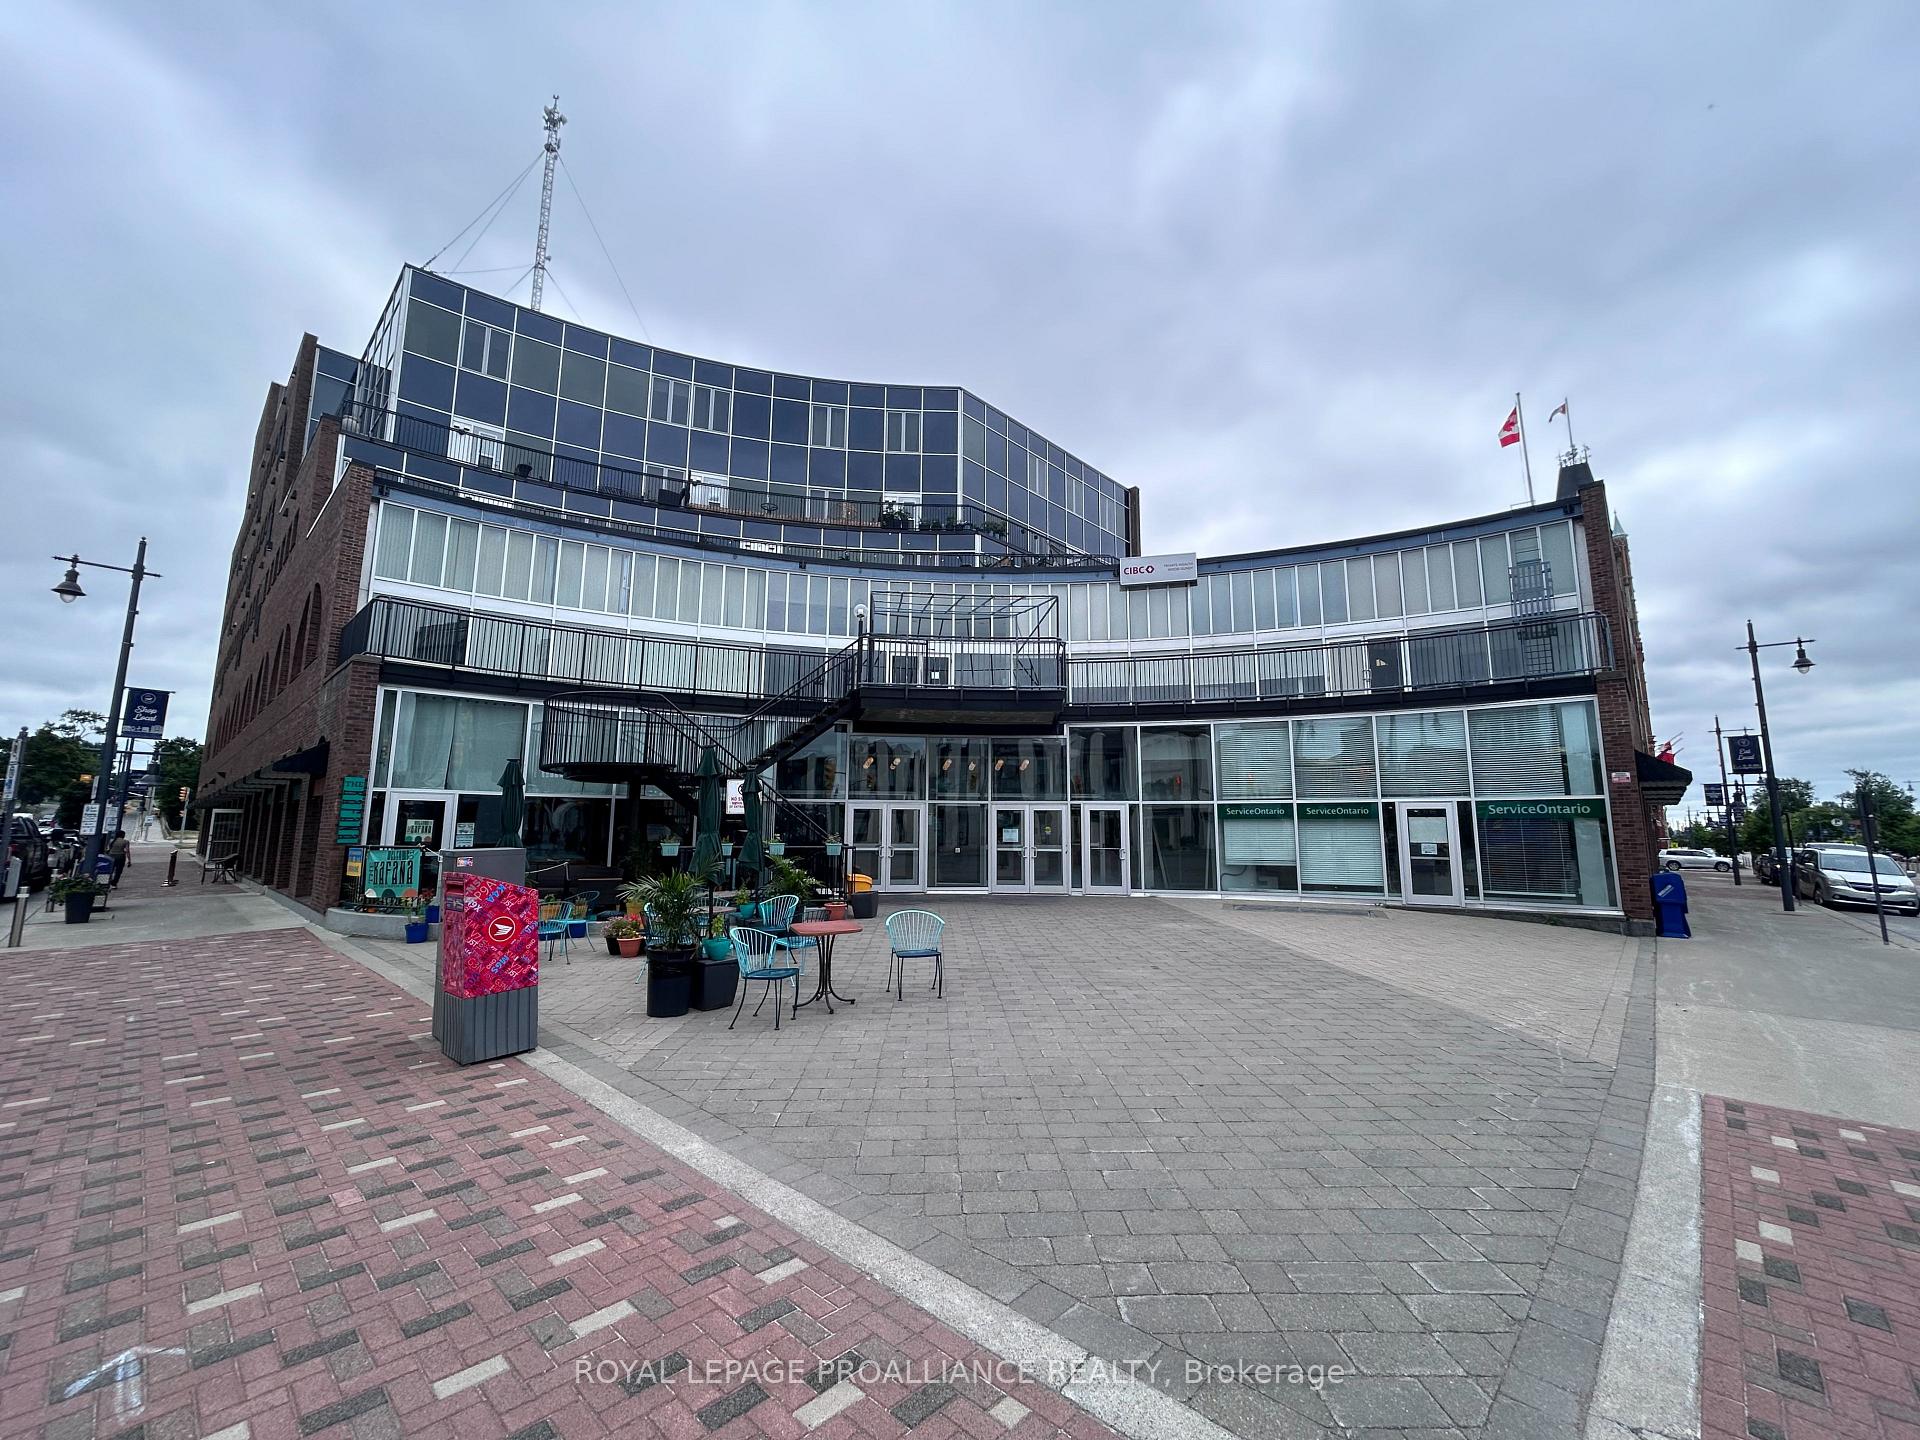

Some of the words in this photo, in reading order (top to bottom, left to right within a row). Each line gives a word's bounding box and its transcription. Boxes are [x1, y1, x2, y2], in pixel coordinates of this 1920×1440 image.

[1124, 566, 1144, 574] CIBC
[134, 706, 157, 714] Shop
[1306, 807, 1369, 815] ServiceOntario
[1488, 804, 1591, 814] ServiceOntario
[373, 860, 413, 884] KAFANA
[474, 881, 497, 901] P9A
